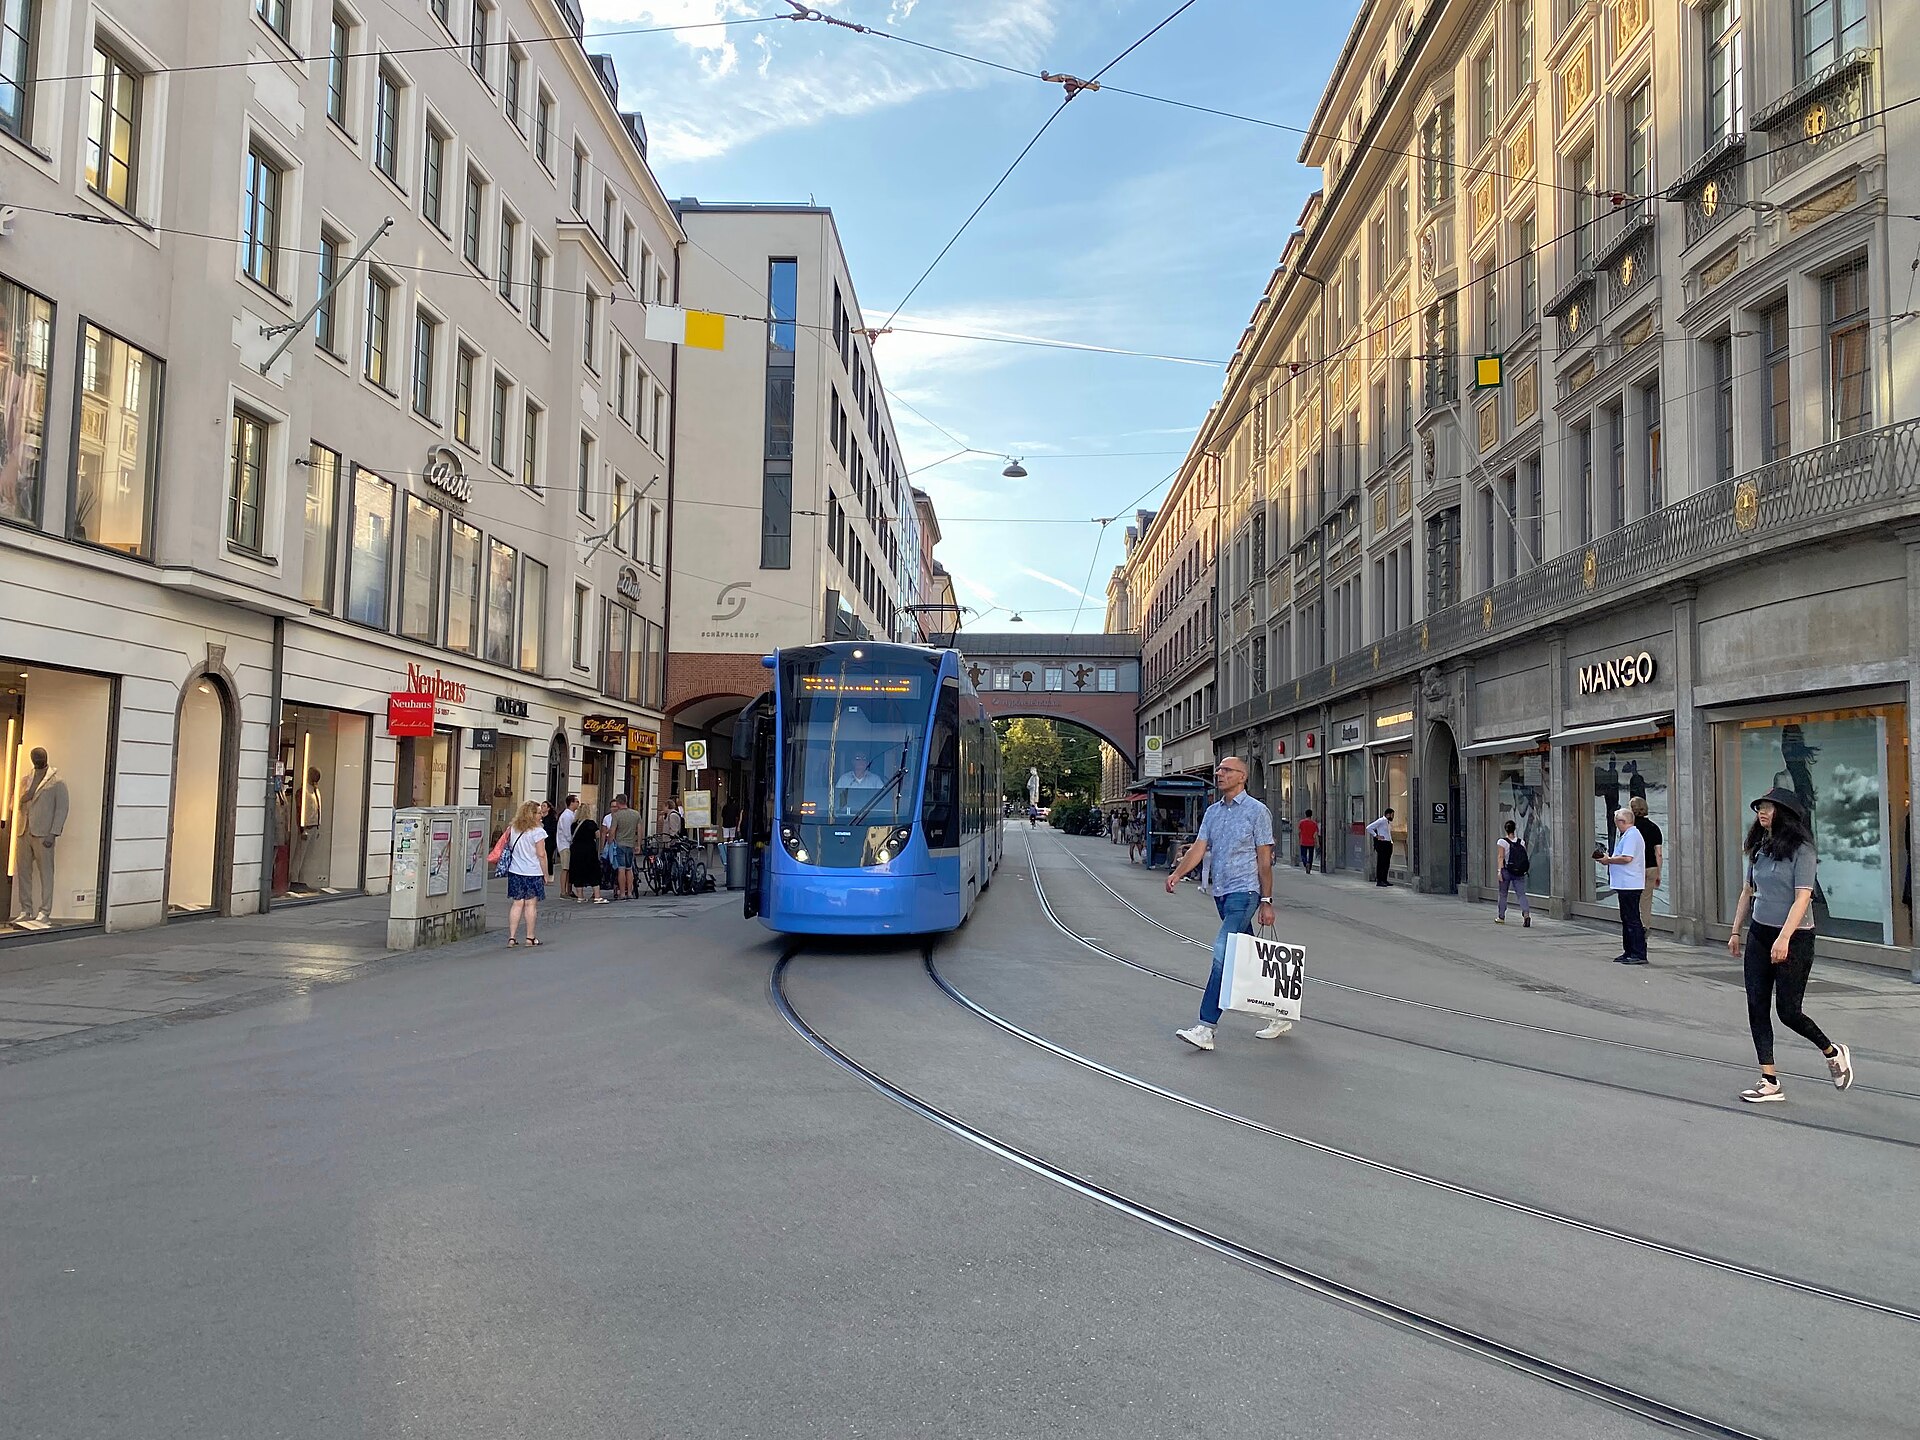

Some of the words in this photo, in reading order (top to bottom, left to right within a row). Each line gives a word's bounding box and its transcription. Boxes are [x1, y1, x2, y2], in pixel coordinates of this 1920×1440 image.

[701, 630, 760, 639] SCHÄFFLERHOF
[406, 662, 467, 704] Neuhaus
[1579, 651, 1654, 695] MANGO
[392, 698, 432, 710] Neuhaus
[1255, 940, 1304, 968] WOR
[1261, 959, 1303, 985] MLA
[1274, 978, 1302, 1001] ND
